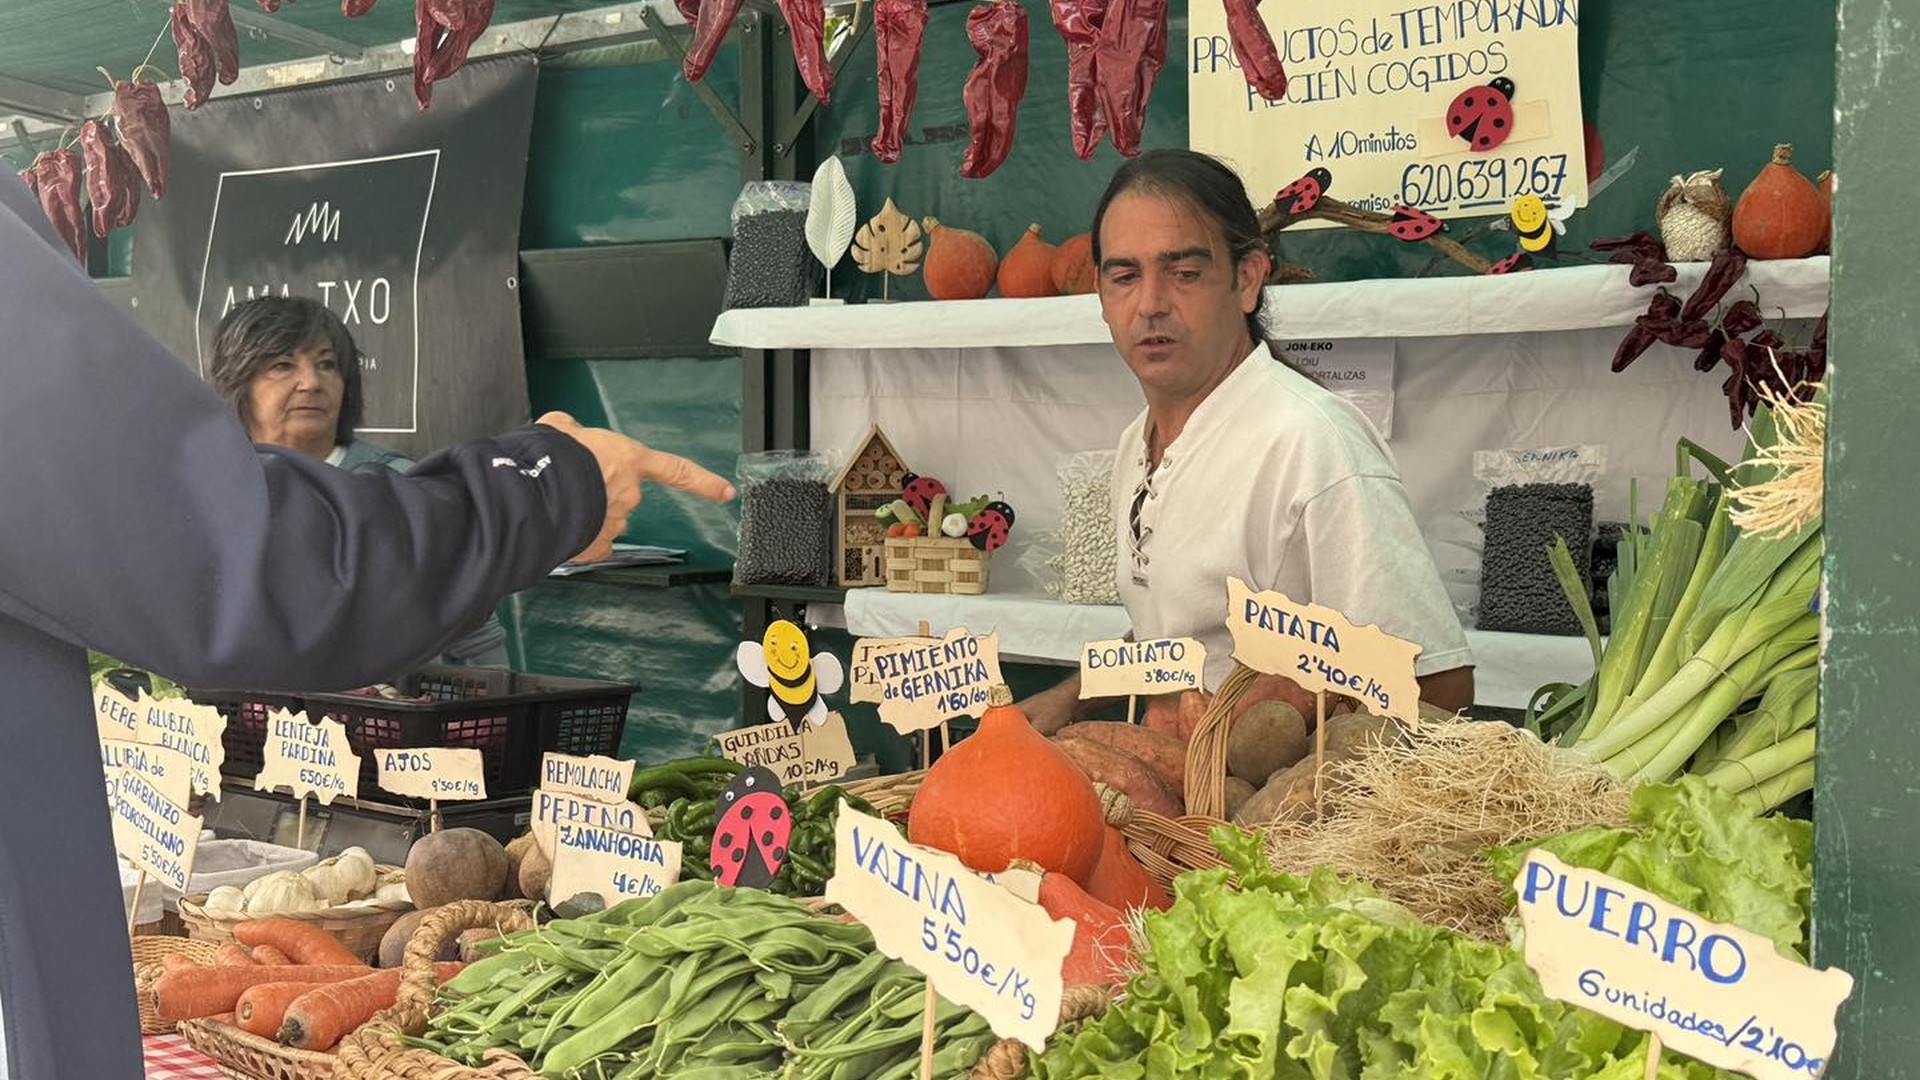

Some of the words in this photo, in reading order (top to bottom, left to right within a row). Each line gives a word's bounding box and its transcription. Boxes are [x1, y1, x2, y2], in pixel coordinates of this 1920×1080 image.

[1361, 18, 1393, 54] de
[1391, 0, 1578, 49] TEMPORADA
[1368, 41, 1508, 94] COGIDOS
[1304, 134, 1324, 161] A
[1402, 154, 1567, 206] 620.639.267
[318, 278, 390, 324] TXO
[1312, 371, 1366, 381] ORTALIZAS
[1244, 598, 1341, 653] PATATA
[875, 637, 978, 679] PIMIENTO
[884, 683, 899, 699] de
[902, 658, 989, 702] GERNIKA
[1298, 653, 1390, 709] 2'40€/Kg
[147, 707, 194, 736] ALUBIA
[275, 720, 329, 748] LENTEJA
[151, 754, 164, 777] de
[281, 741, 336, 767] PARDINA
[385, 752, 432, 772] AJOS
[546, 759, 622, 794] REMOLACHA
[122, 770, 180, 825] GARBANZO
[116, 796, 185, 857] PEDROSILLANO
[560, 825, 664, 867] ZANAHORIA
[853, 826, 966, 926] VAINA
[1523, 861, 1746, 984] PUERRO
[921, 917, 1036, 1020] 5'50€/Kg
